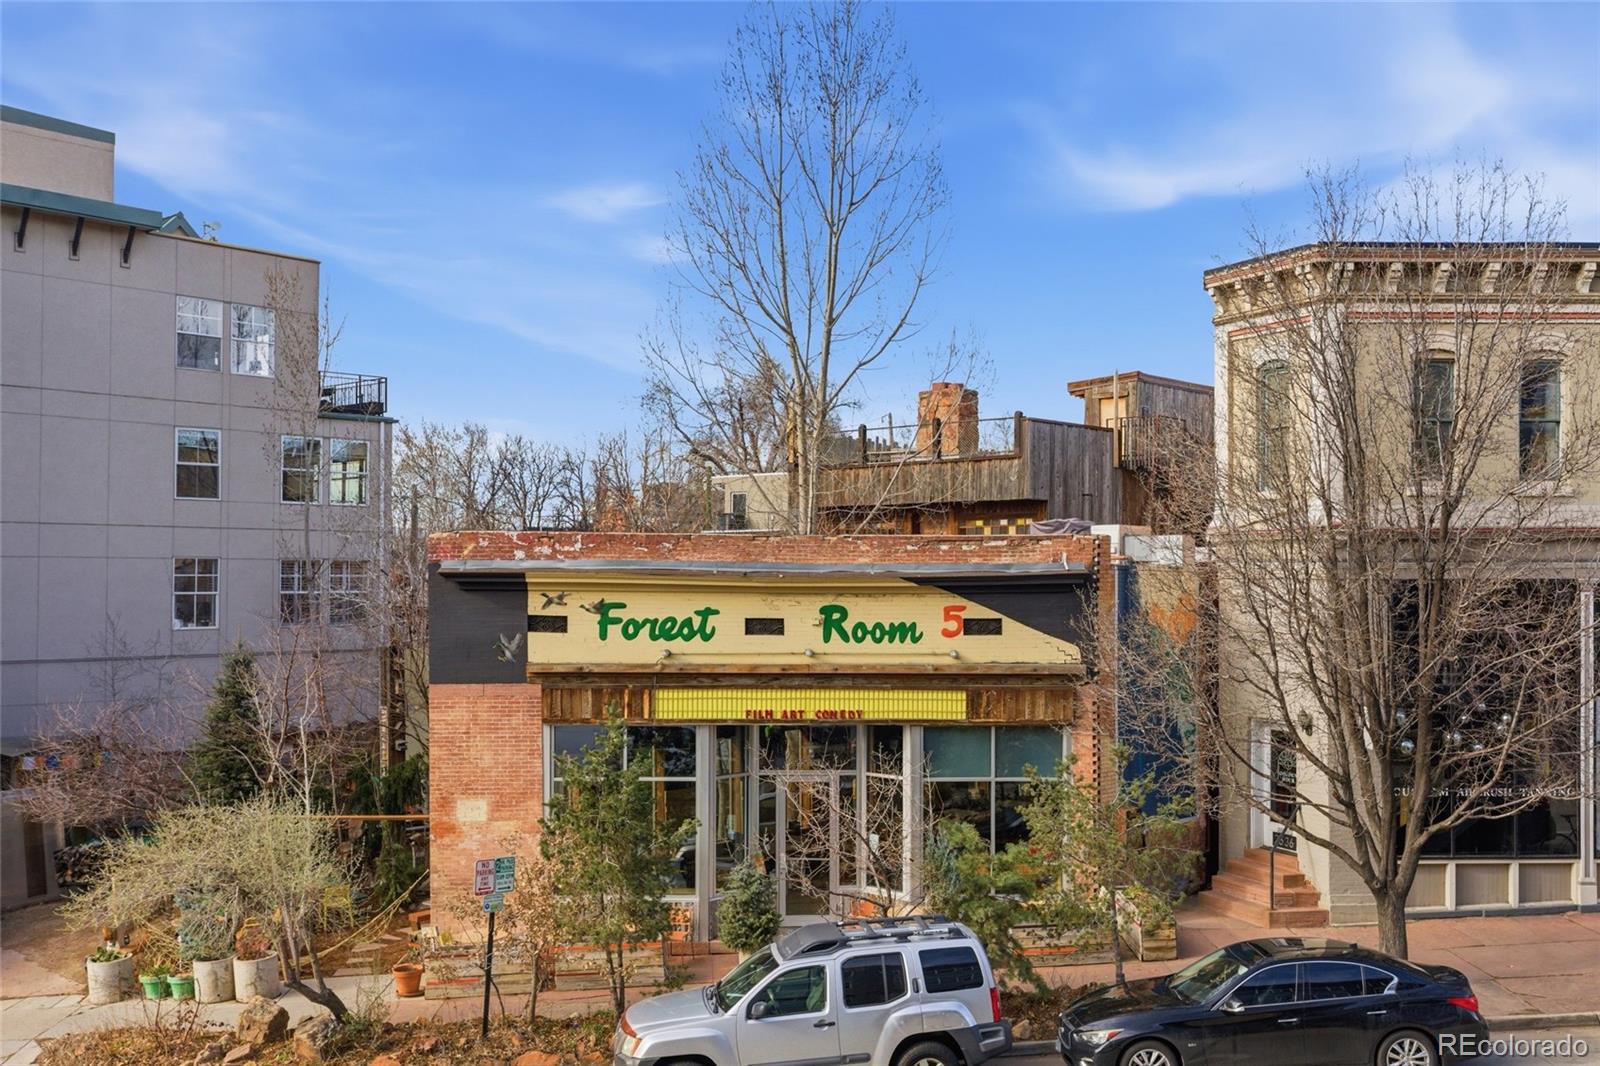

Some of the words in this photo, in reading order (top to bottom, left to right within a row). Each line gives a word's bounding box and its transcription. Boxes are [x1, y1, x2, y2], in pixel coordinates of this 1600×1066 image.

[597, 602, 720, 642] Forest
[819, 604, 924, 644] Room
[940, 605, 968, 638] 5
[745, 709, 773, 719] FILM
[781, 709, 805, 719] ART
[815, 709, 863, 719] COMEDY
